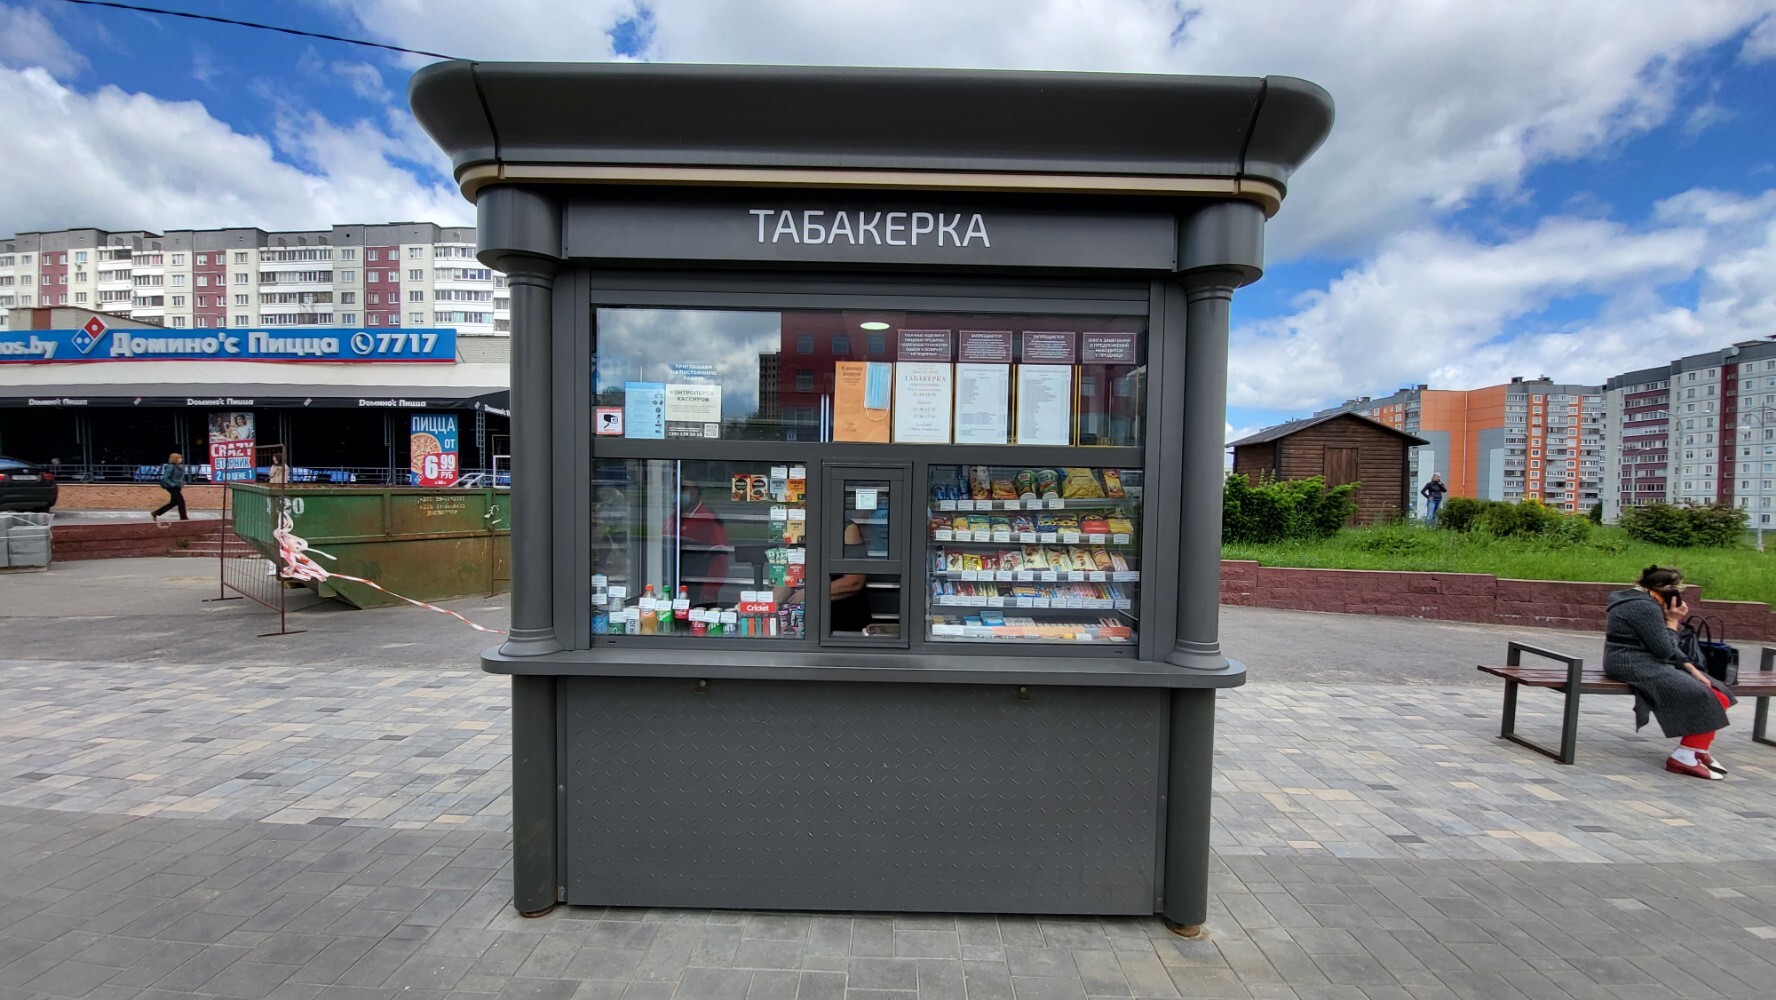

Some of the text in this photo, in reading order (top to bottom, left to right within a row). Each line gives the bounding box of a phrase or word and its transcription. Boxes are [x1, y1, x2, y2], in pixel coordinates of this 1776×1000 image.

[749, 209, 991, 248] ТАБАКЕРКА
[0, 336, 58, 358] os.by
[248, 332, 340, 356] Пицца
[376, 333, 439, 354] 7717
[412, 416, 455, 434] ПИЦЦА
[210, 442, 254, 457] CRAZY
[444, 439, 456, 448] ОТ
[425, 454, 456, 479] 6 99
